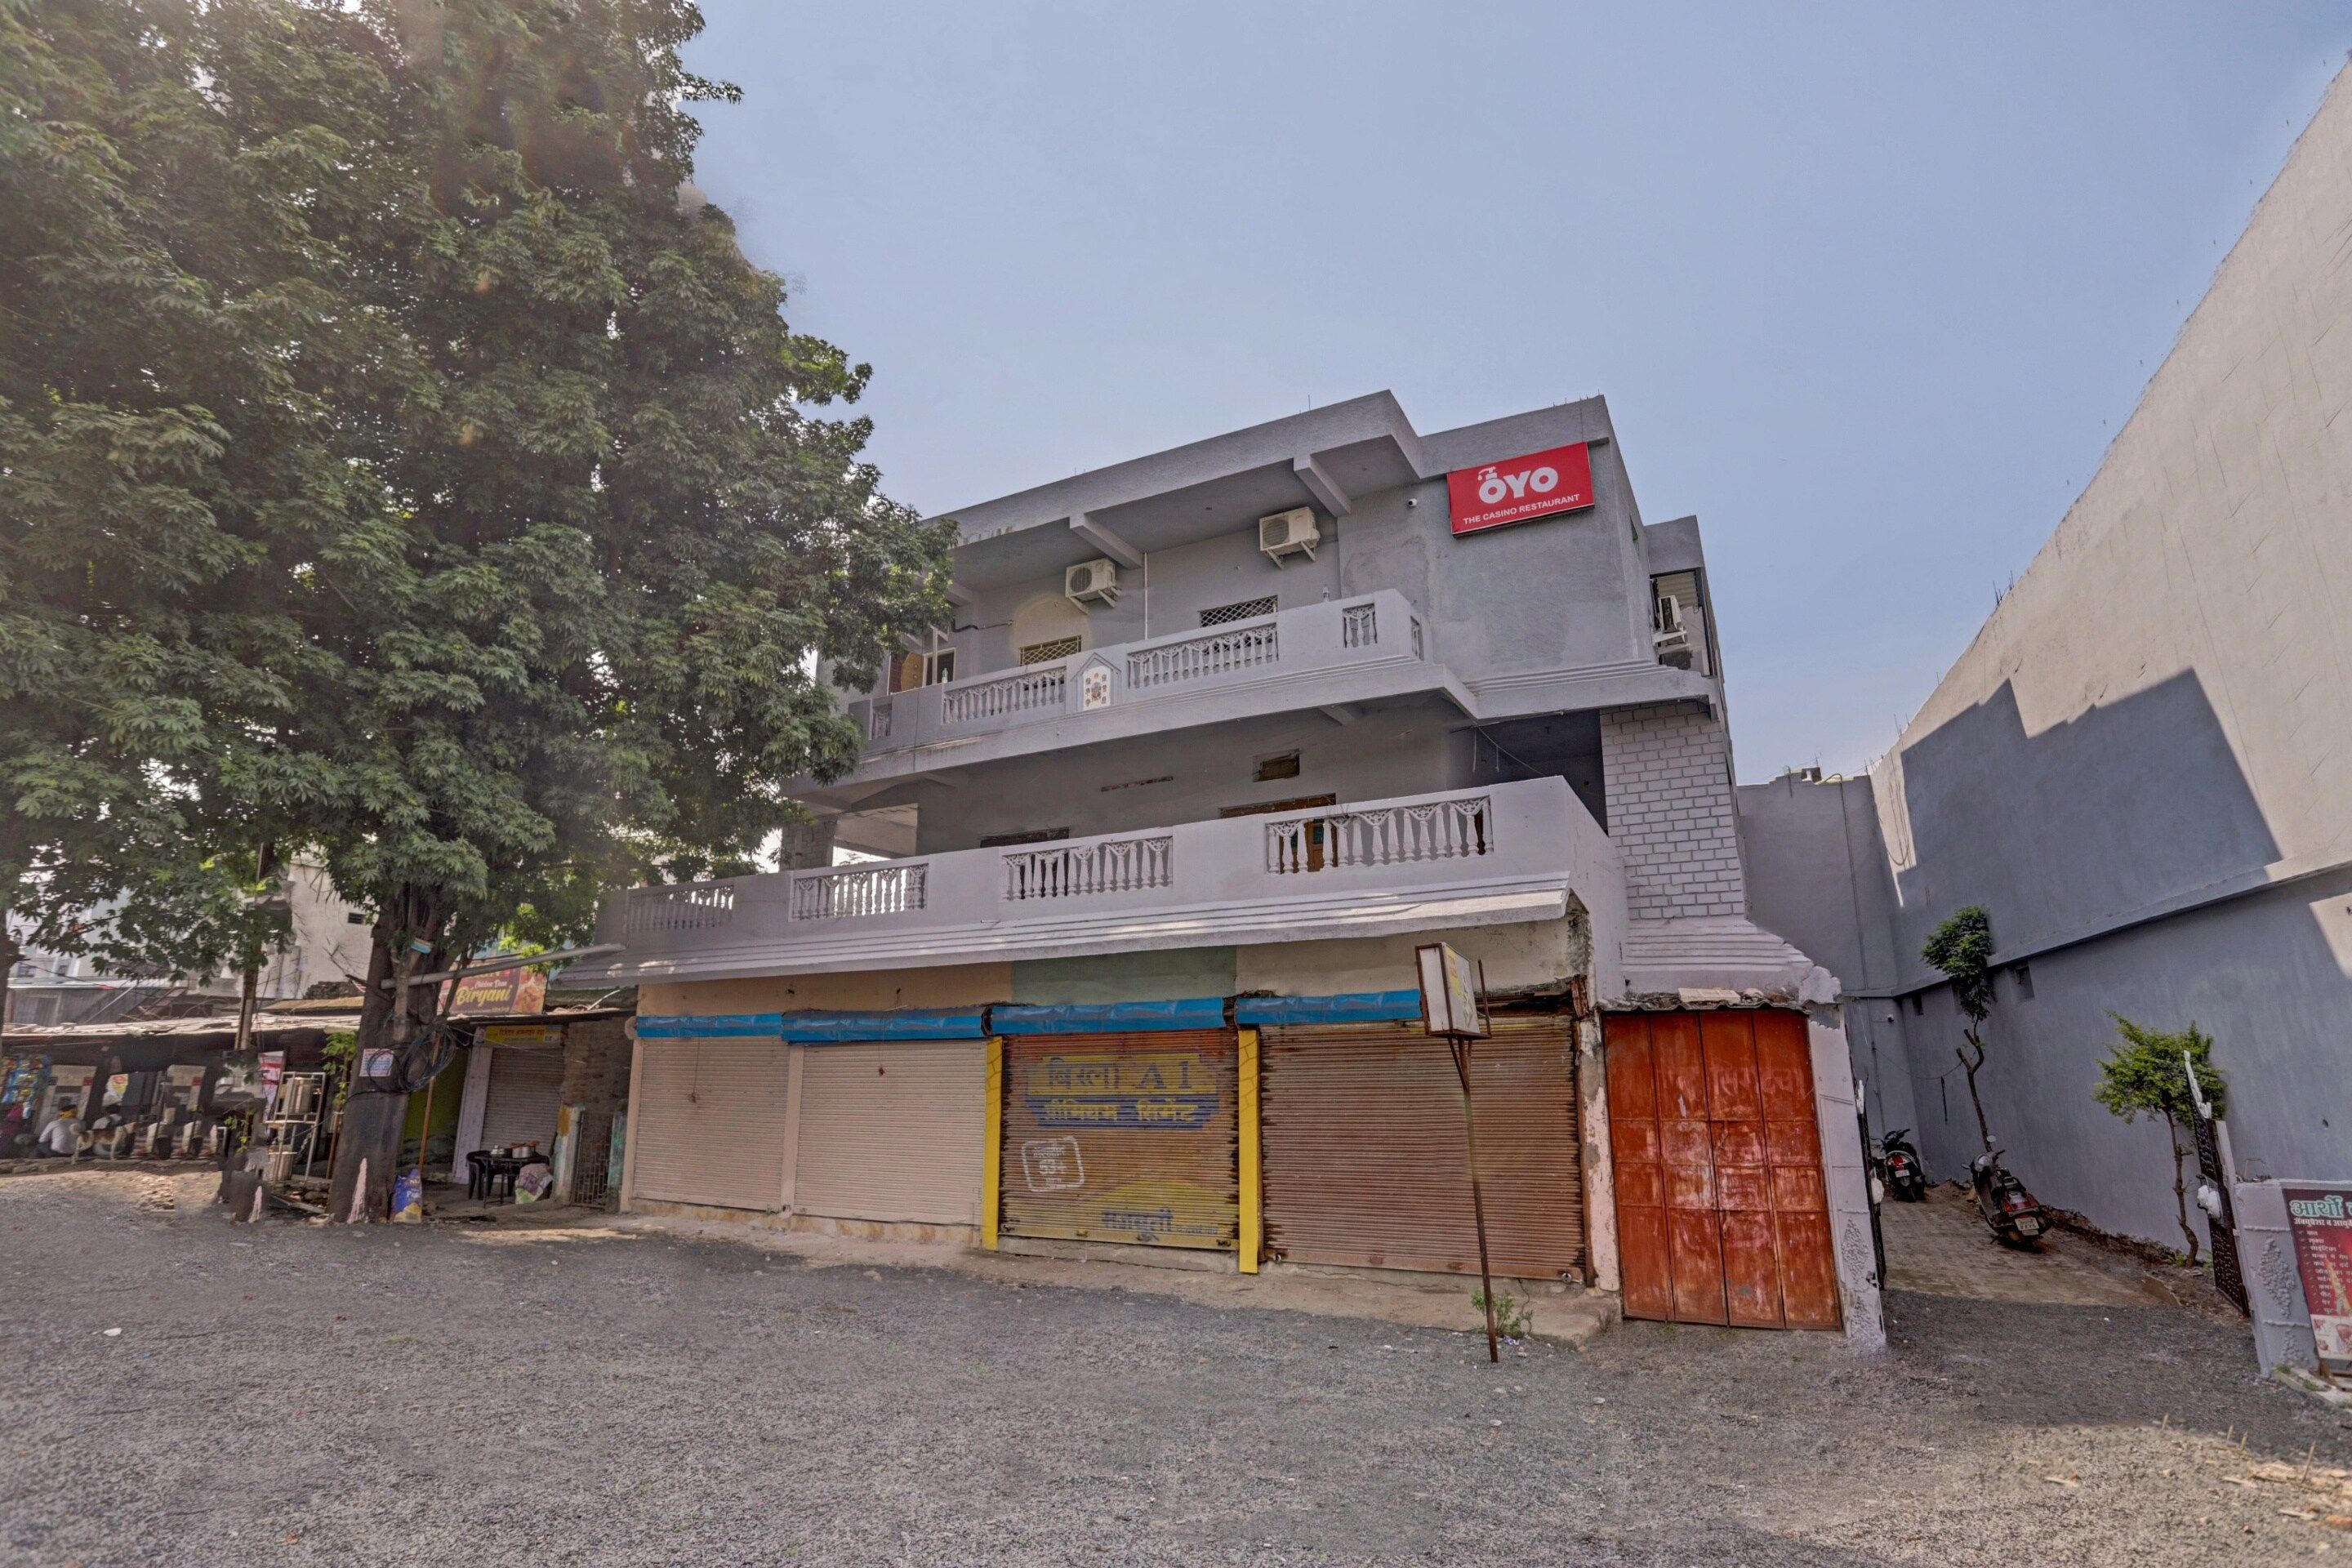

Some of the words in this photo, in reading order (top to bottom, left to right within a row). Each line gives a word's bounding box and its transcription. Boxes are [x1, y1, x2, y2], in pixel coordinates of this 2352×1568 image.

[1478, 466, 1558, 504] OYO
[1463, 515, 1481, 525] THE
[1482, 507, 1517, 520] CASINO
[1519, 494, 1580, 513] RESTAURANT
[457, 985, 513, 1007] Biryani
